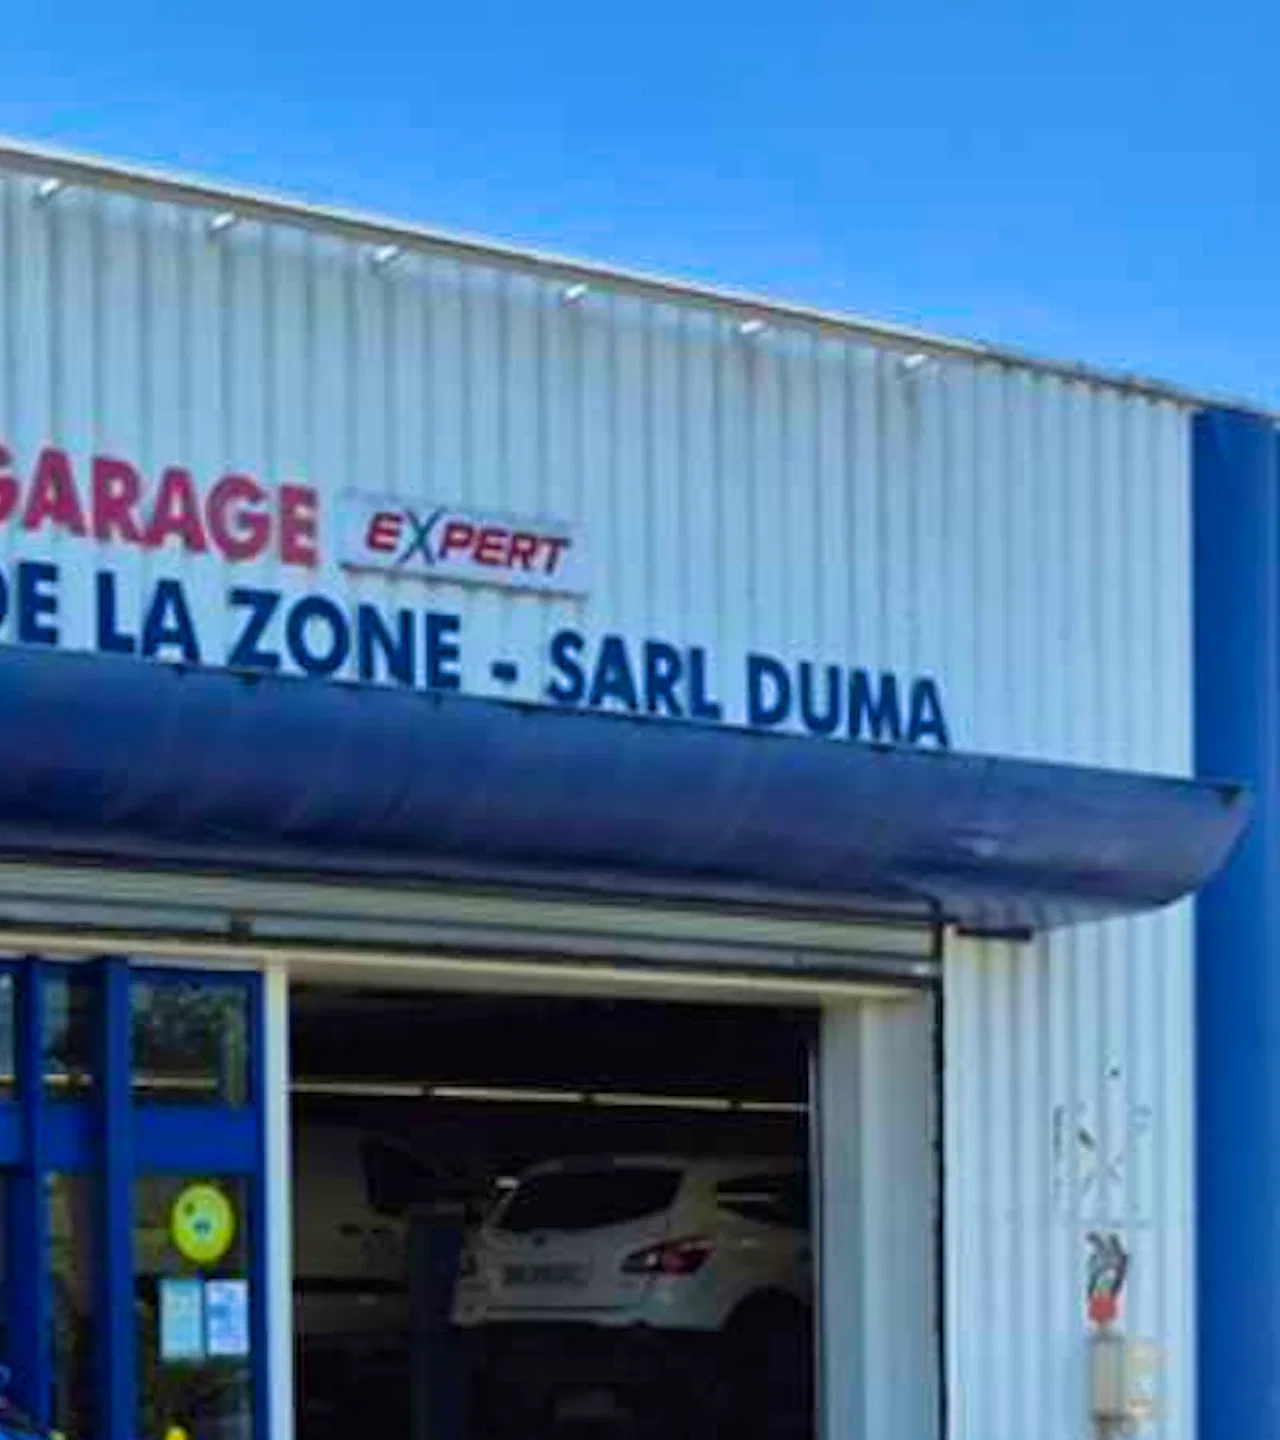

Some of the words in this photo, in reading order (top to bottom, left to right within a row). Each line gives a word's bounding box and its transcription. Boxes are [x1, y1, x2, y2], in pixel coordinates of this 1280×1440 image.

[366, 508, 572, 575] EXPERT
[96, 570, 201, 664] LA
[228, 586, 461, 690] ZONE
[548, 629, 721, 721] SARL
[746, 652, 950, 747] DUMA
